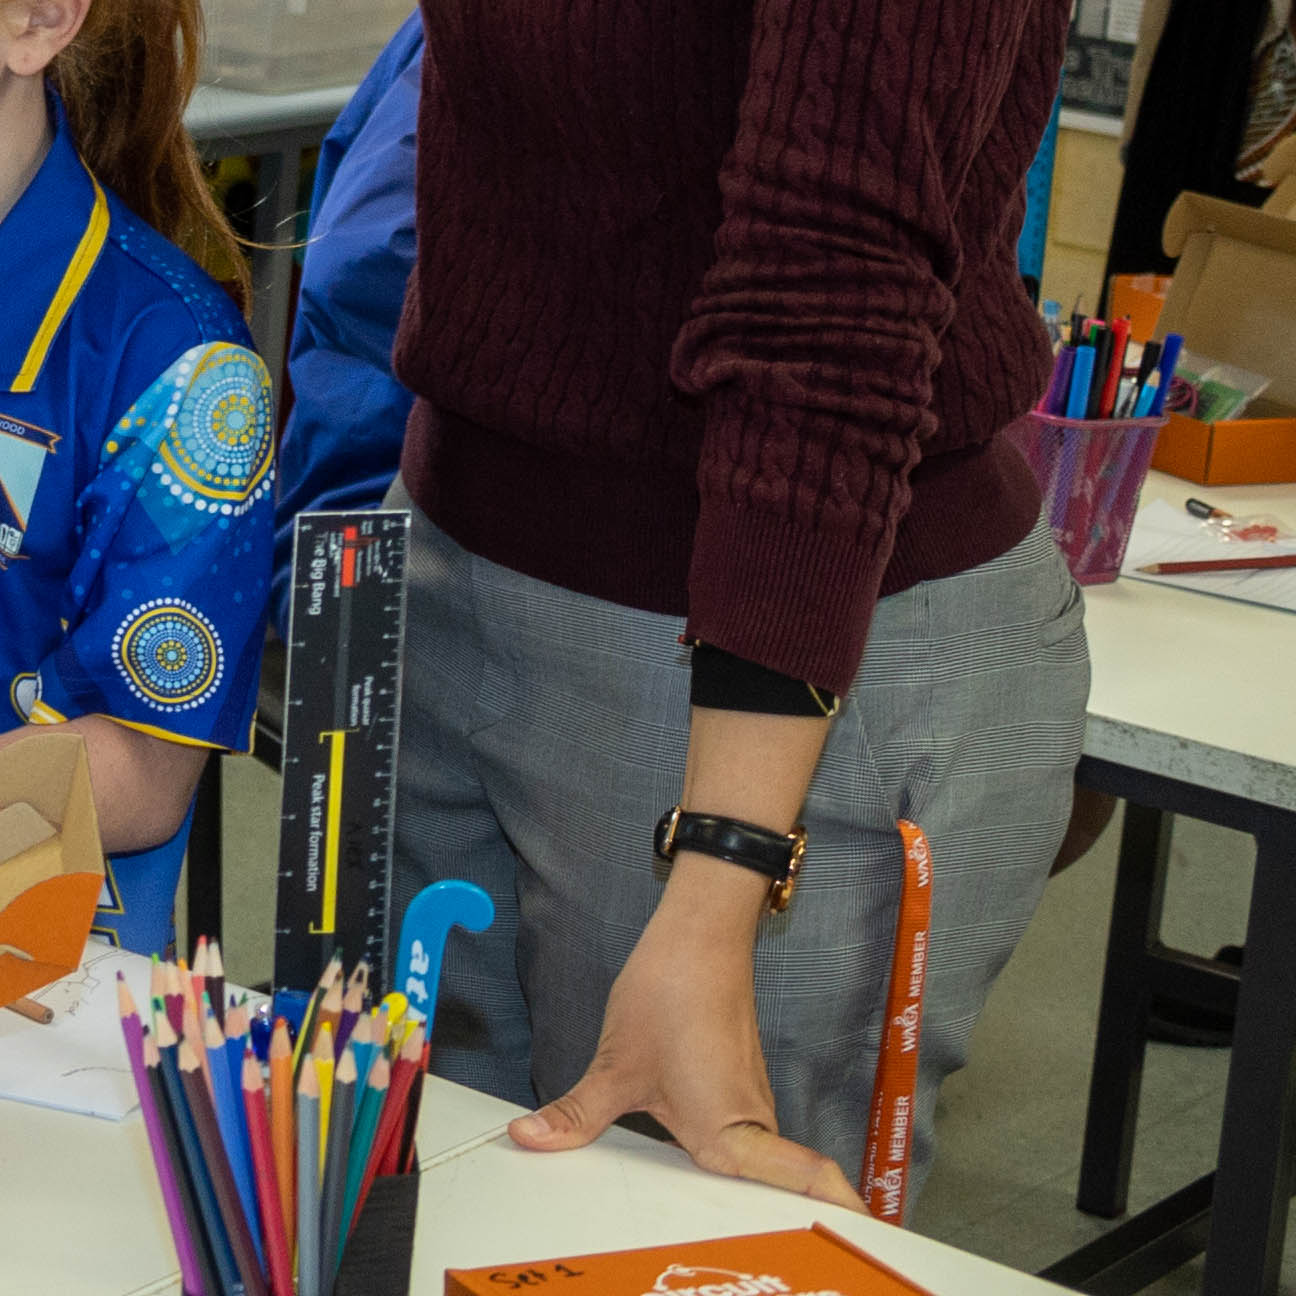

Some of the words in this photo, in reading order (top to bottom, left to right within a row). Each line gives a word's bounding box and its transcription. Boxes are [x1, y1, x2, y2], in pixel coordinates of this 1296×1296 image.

[314, 531, 330, 556] The
[310, 558, 328, 580] Big
[308, 582, 327, 616] Bang
[310, 773, 326, 803] Peak
[309, 806, 323, 830] star
[307, 830, 323, 892] formation
[908, 930, 927, 998] MEMBER
[891, 1095, 910, 1162] MEMBER
[489, 1269, 548, 1292] Set
